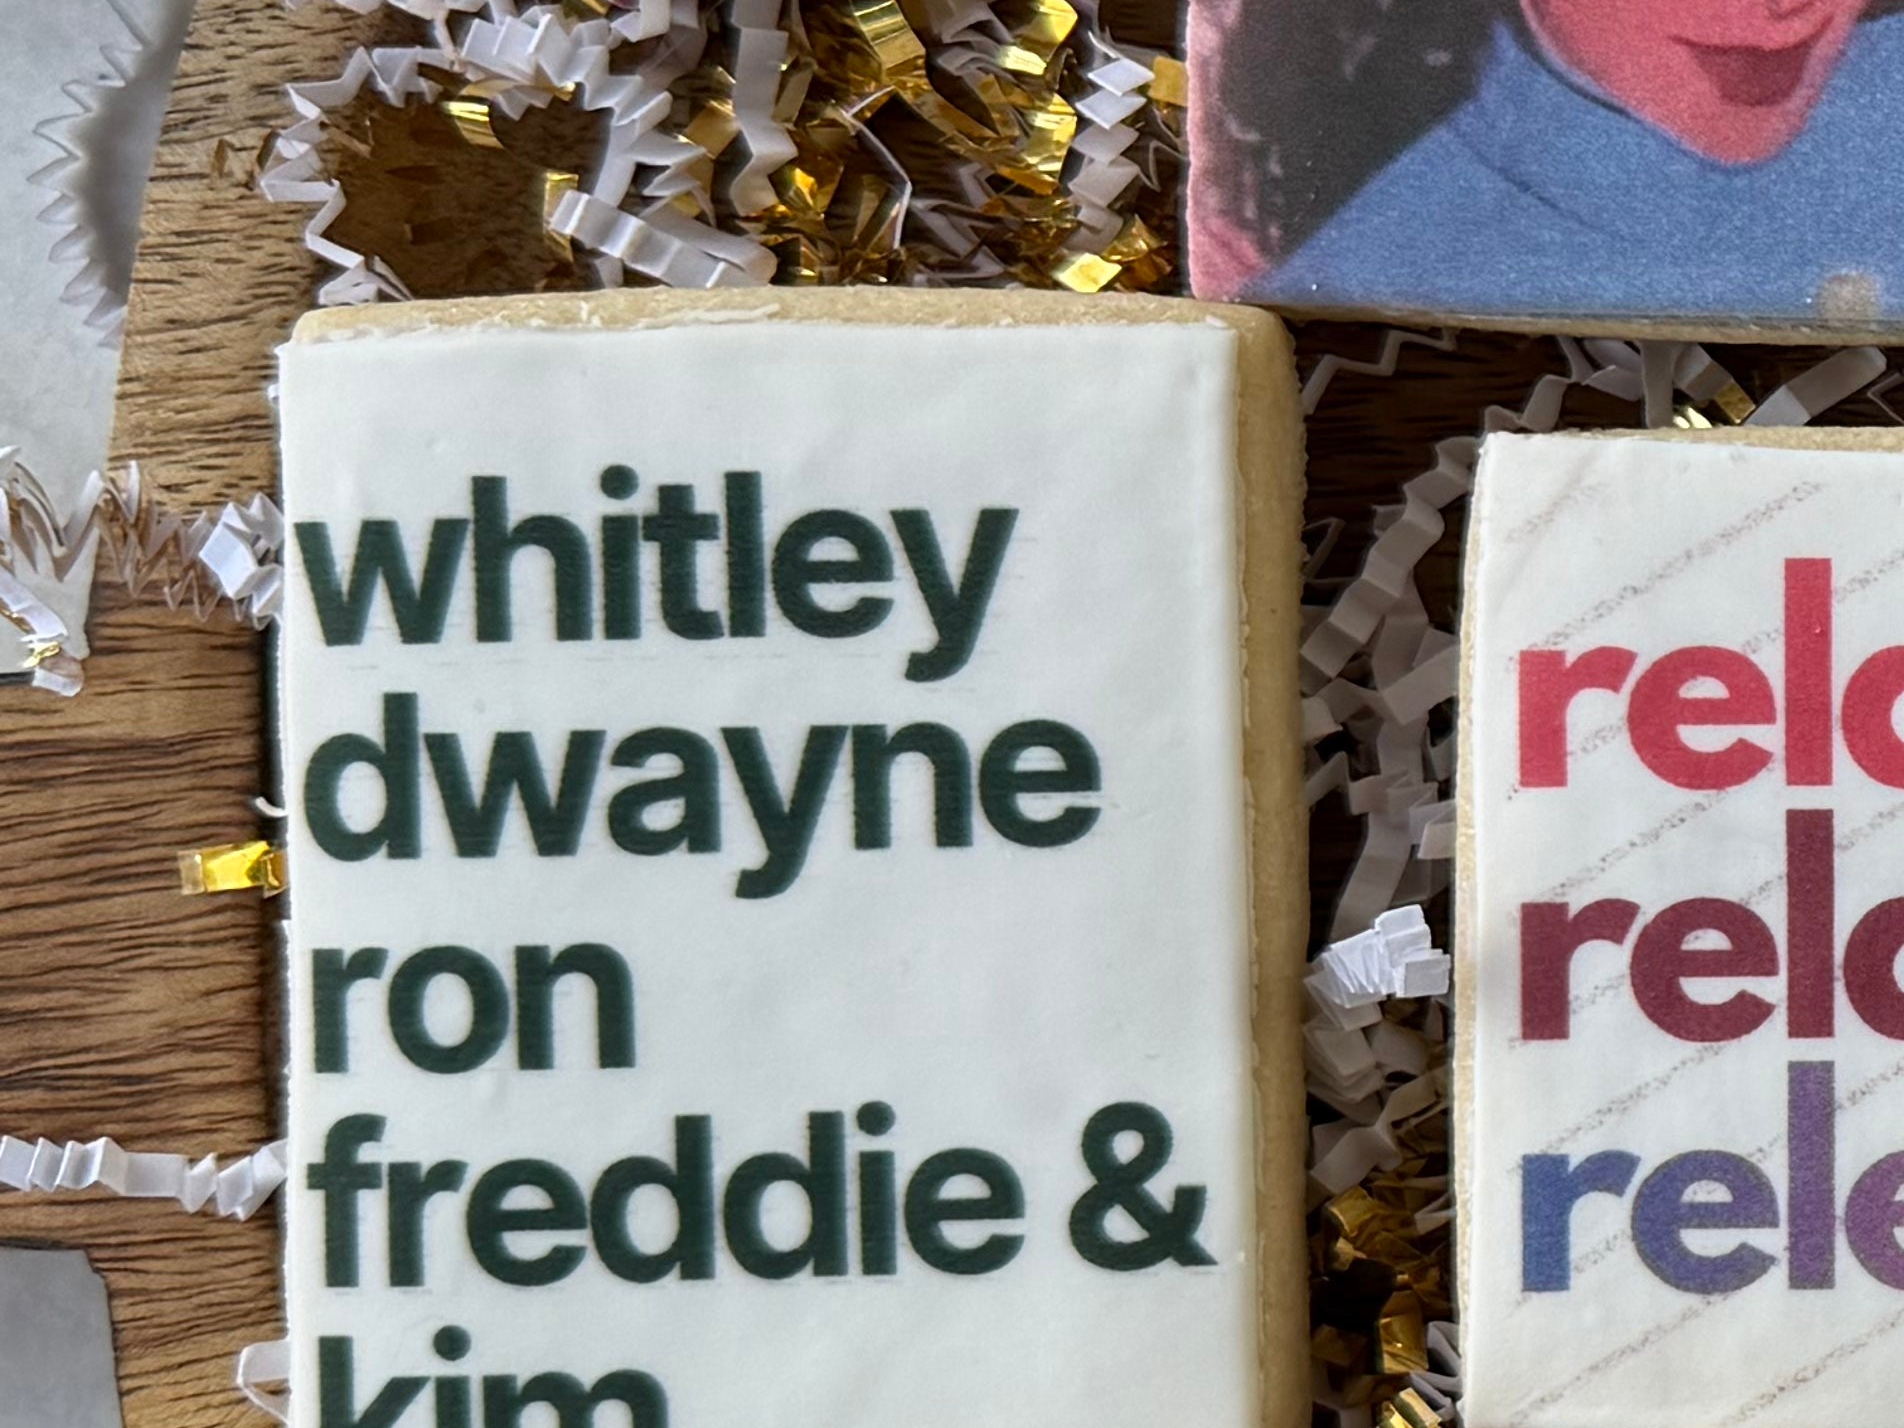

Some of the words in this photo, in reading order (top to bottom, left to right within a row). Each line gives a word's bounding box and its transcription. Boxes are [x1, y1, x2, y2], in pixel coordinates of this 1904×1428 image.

[295, 464, 1019, 684] whitley
[303, 692, 1101, 899] dwayne
[311, 940, 637, 1075] ron
[307, 1101, 1026, 1289] freddie
[1069, 1101, 1219, 1274] &
